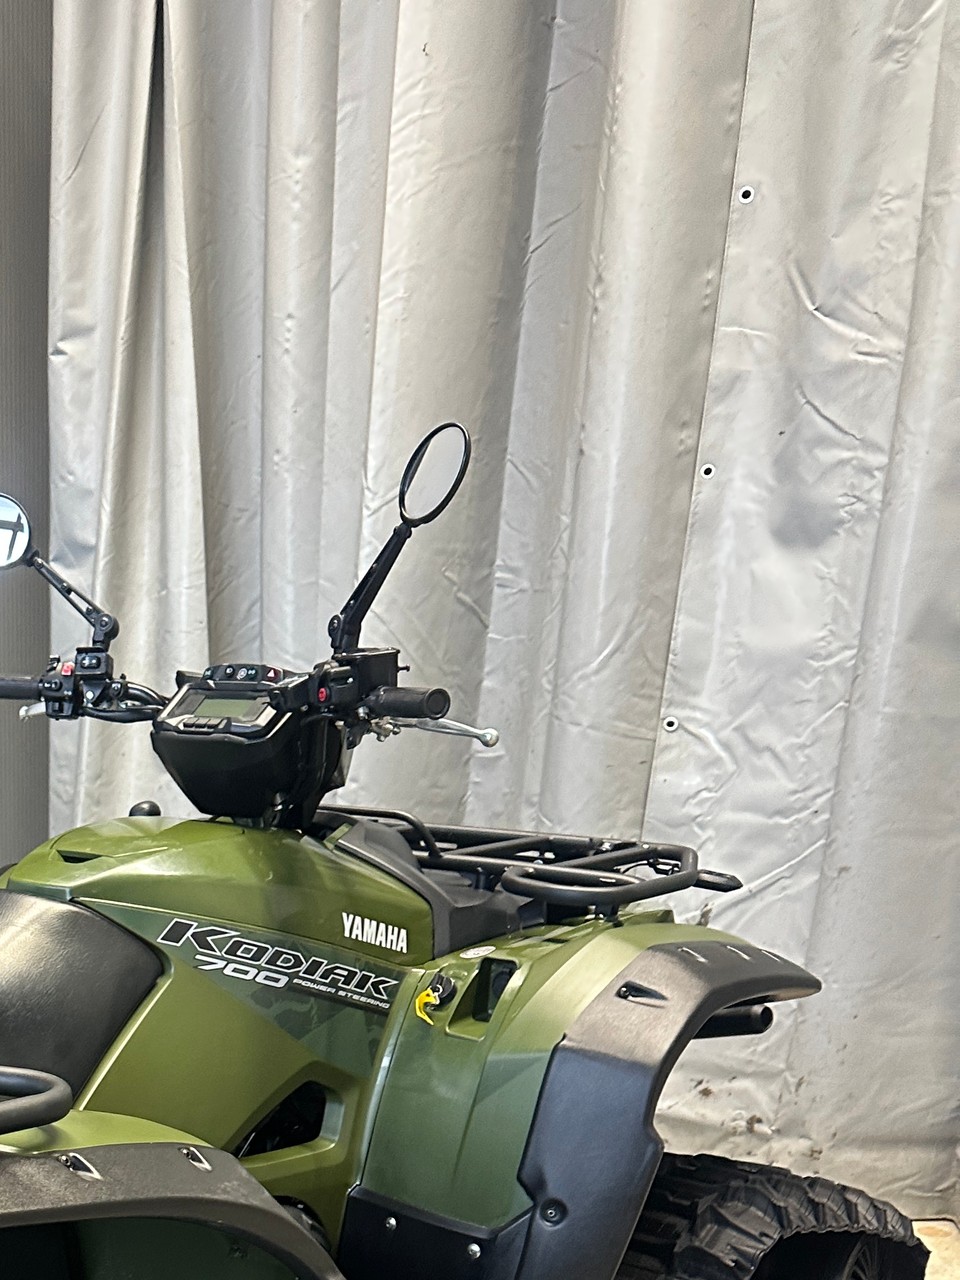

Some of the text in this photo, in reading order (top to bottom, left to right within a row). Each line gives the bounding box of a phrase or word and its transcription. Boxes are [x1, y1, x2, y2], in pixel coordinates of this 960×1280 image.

[341, 911, 408, 954] YAMAHA
[156, 917, 400, 1001] KODIAK
[194, 953, 291, 989] 700
[292, 977, 391, 1010] POWER STEERING
